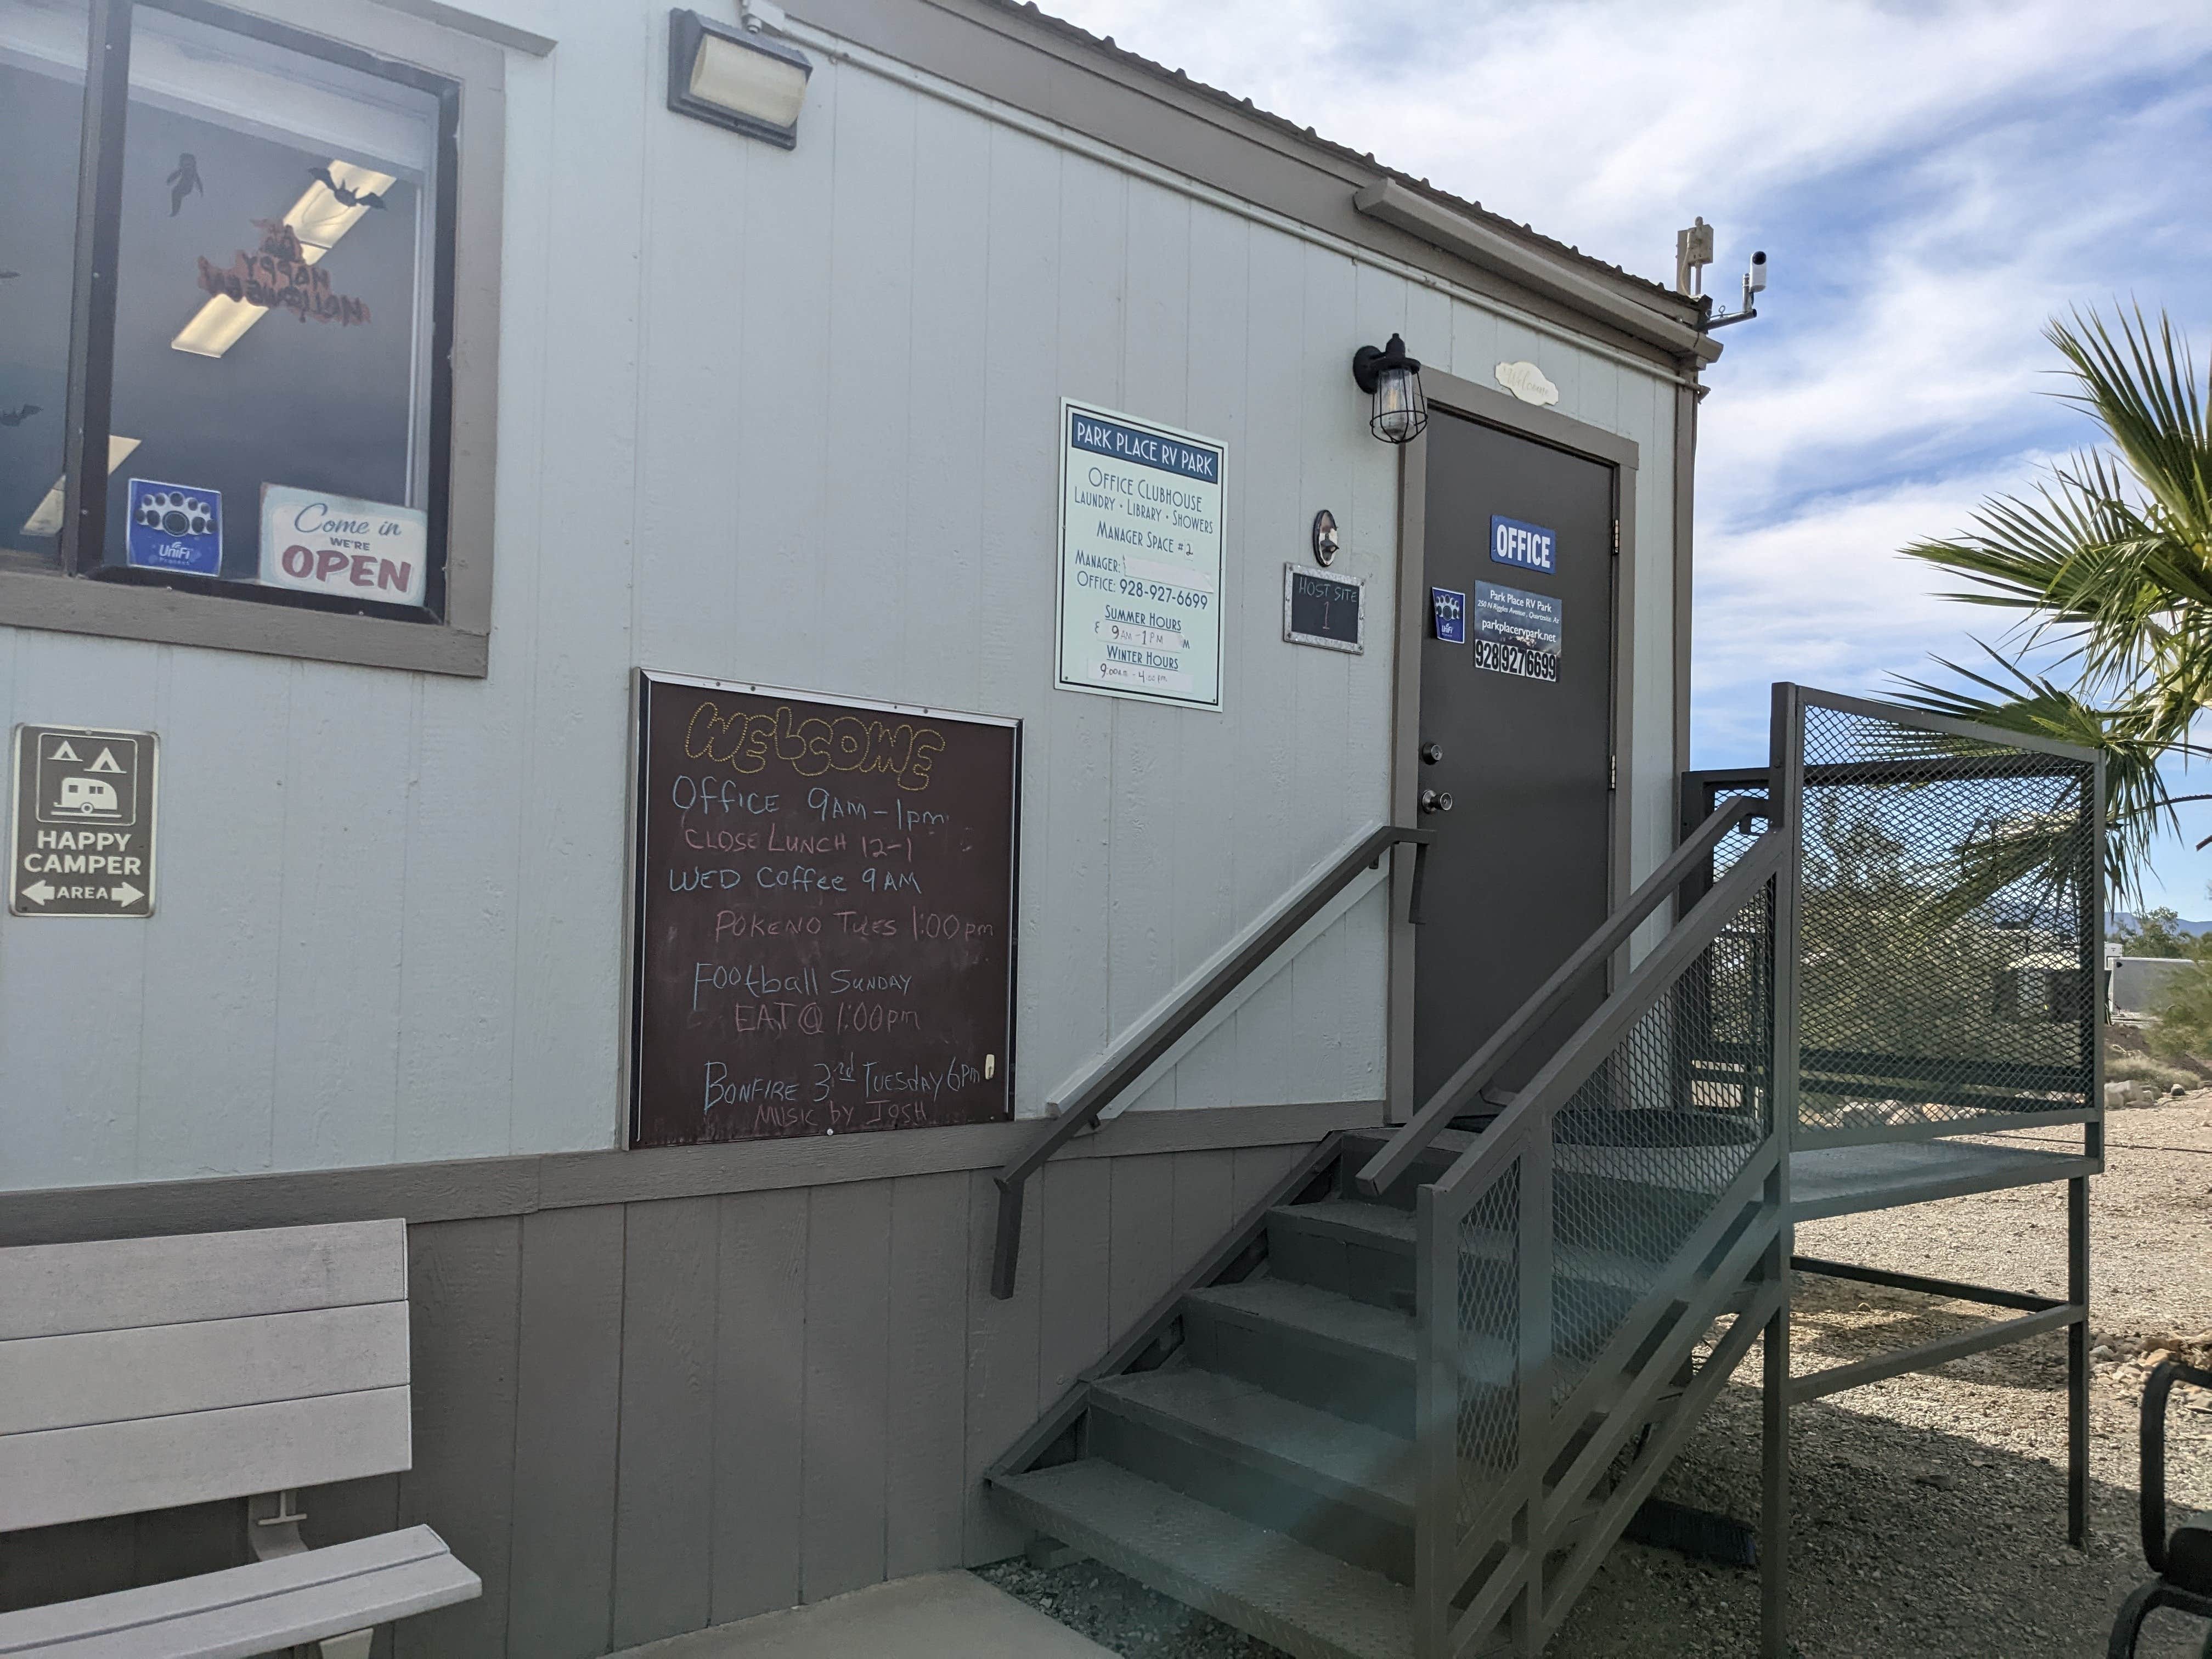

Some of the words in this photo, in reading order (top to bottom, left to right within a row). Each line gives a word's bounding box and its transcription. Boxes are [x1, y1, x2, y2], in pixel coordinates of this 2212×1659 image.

[1077, 422, 1113, 450] PARK
[1116, 432, 1157, 462] PLACE
[1162, 445, 1177, 466] RV
[1181, 450, 1213, 477] PARK
[1088, 467, 1133, 495] OFFICE
[1138, 479, 1203, 512] CLUBHOUSE
[294, 503, 370, 535] Come
[379, 520, 403, 536] in
[1074, 486, 1116, 511] LAUNDRY
[1127, 498, 1162, 522] LIBRARY
[1172, 510, 1214, 534] SHOWERS
[330, 537, 370, 551] WE'RE
[1097, 520, 1143, 548] MANAGER
[1147, 531, 1174, 553] SPACE
[1497, 524, 1550, 568] OFFICE
[281, 544, 412, 592] OPEN
[1075, 550, 1121, 573] MANAGER:
[1077, 571, 1116, 593] OFFICE:
[1120, 578, 1208, 610] 928-927-6699
[1299, 576, 1330, 598] HOST
[1334, 587, 1357, 602] SITE
[1490, 590, 1505, 602] Park
[1507, 594, 1524, 606] Place
[1526, 598, 1536, 608] RV
[1537, 601, 1552, 613] Park
[1105, 604, 1146, 625] SUMMER
[1149, 612, 1182, 631] HOURS
[1323, 601, 1330, 629] 1
[1482, 619, 1556, 642] parkplacervpark.net
[1107, 645, 1142, 663] WINTER
[1147, 651, 1178, 669] HOURS
[685, 702, 946, 791] WELCOME
[37, 830, 132, 851] HAPPY
[686, 828, 759, 851] CLOSE
[768, 823, 847, 854] LUNCH
[24, 854, 141, 875] CAMPER
[669, 866, 740, 891] WED
[57, 887, 109, 900] AREA
[716, 910, 821, 943] POKENO
[704, 1060, 799, 1115] BONFIRE
[754, 1104, 819, 1129] MUSIC
[829, 1100, 854, 1125] by
[866, 1100, 927, 1125] JOSH
